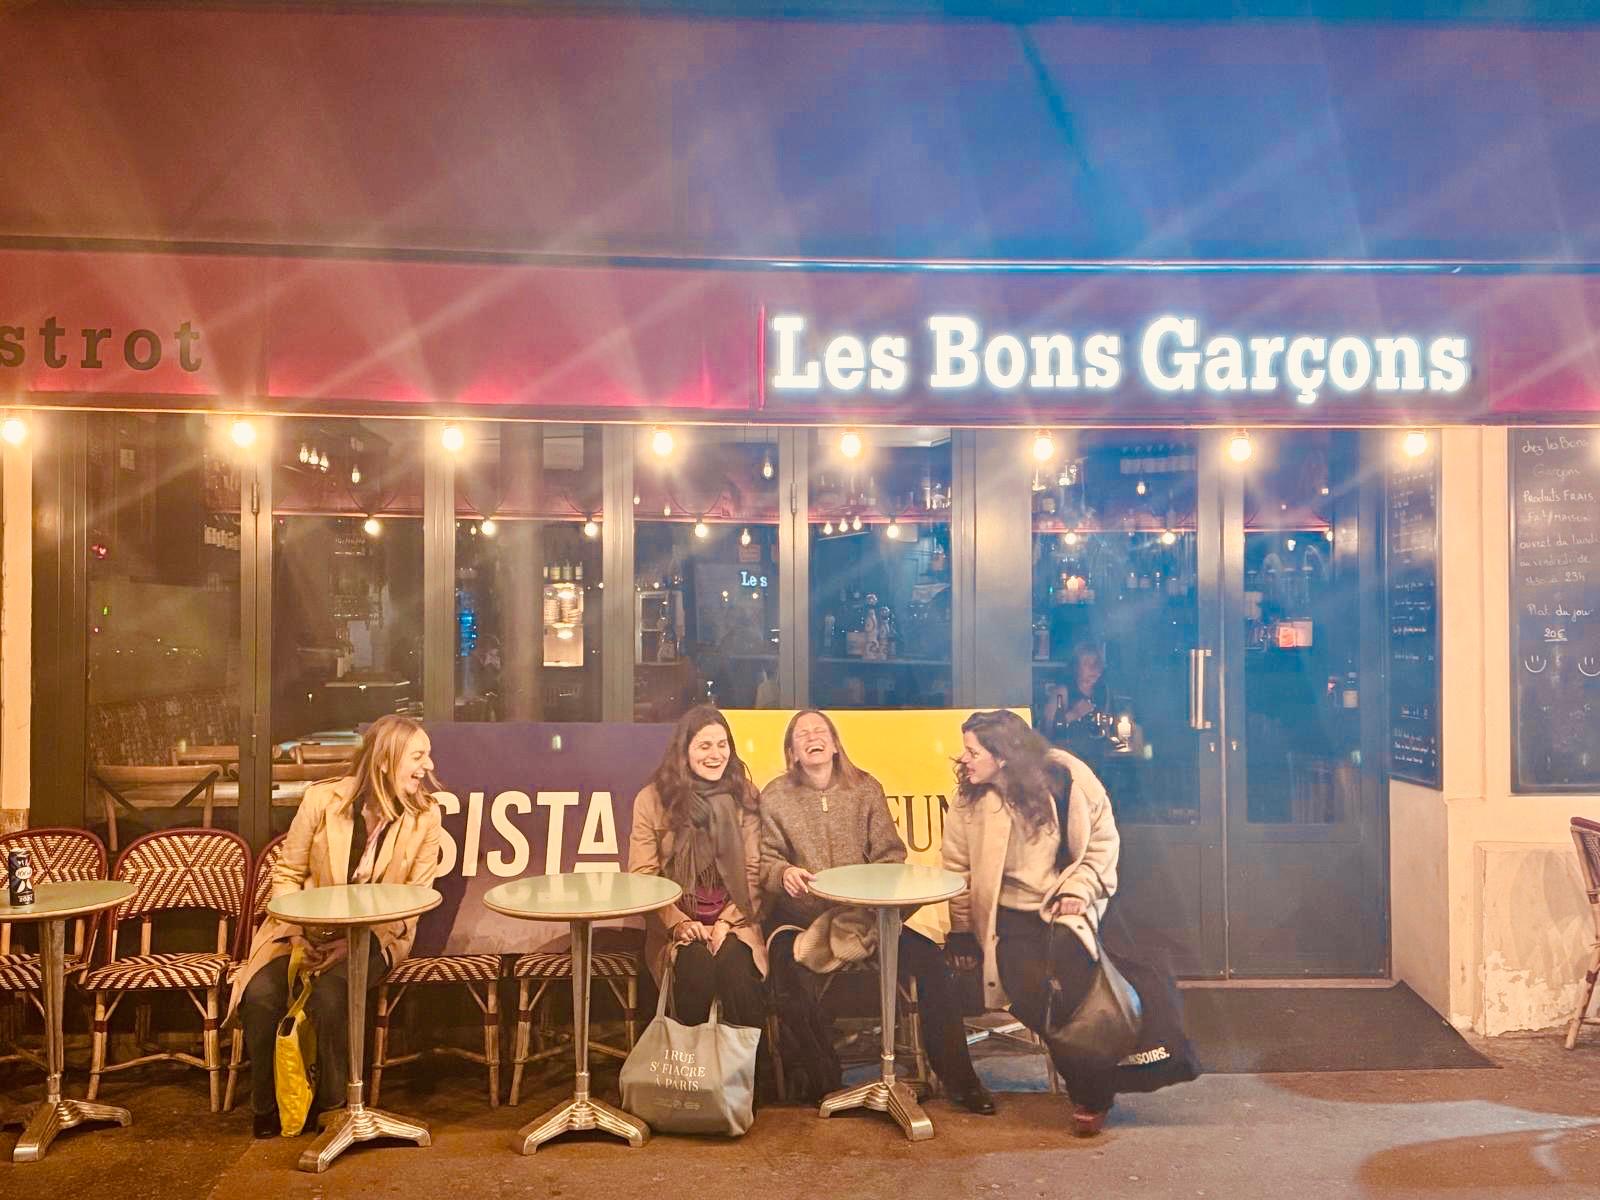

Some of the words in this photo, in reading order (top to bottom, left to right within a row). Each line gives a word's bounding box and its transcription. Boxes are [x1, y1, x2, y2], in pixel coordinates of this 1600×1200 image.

[0, 316, 202, 372] strot
[772, 316, 907, 391] Les
[928, 315, 1122, 390] Bons
[1141, 316, 1468, 404] Garçons
[740, 571, 768, 587] Les
[1556, 603, 1571, 616] du
[430, 791, 621, 877] SISTA
[661, 1063, 707, 1078] FIACRE
[665, 1077, 700, 1092] PARIS
